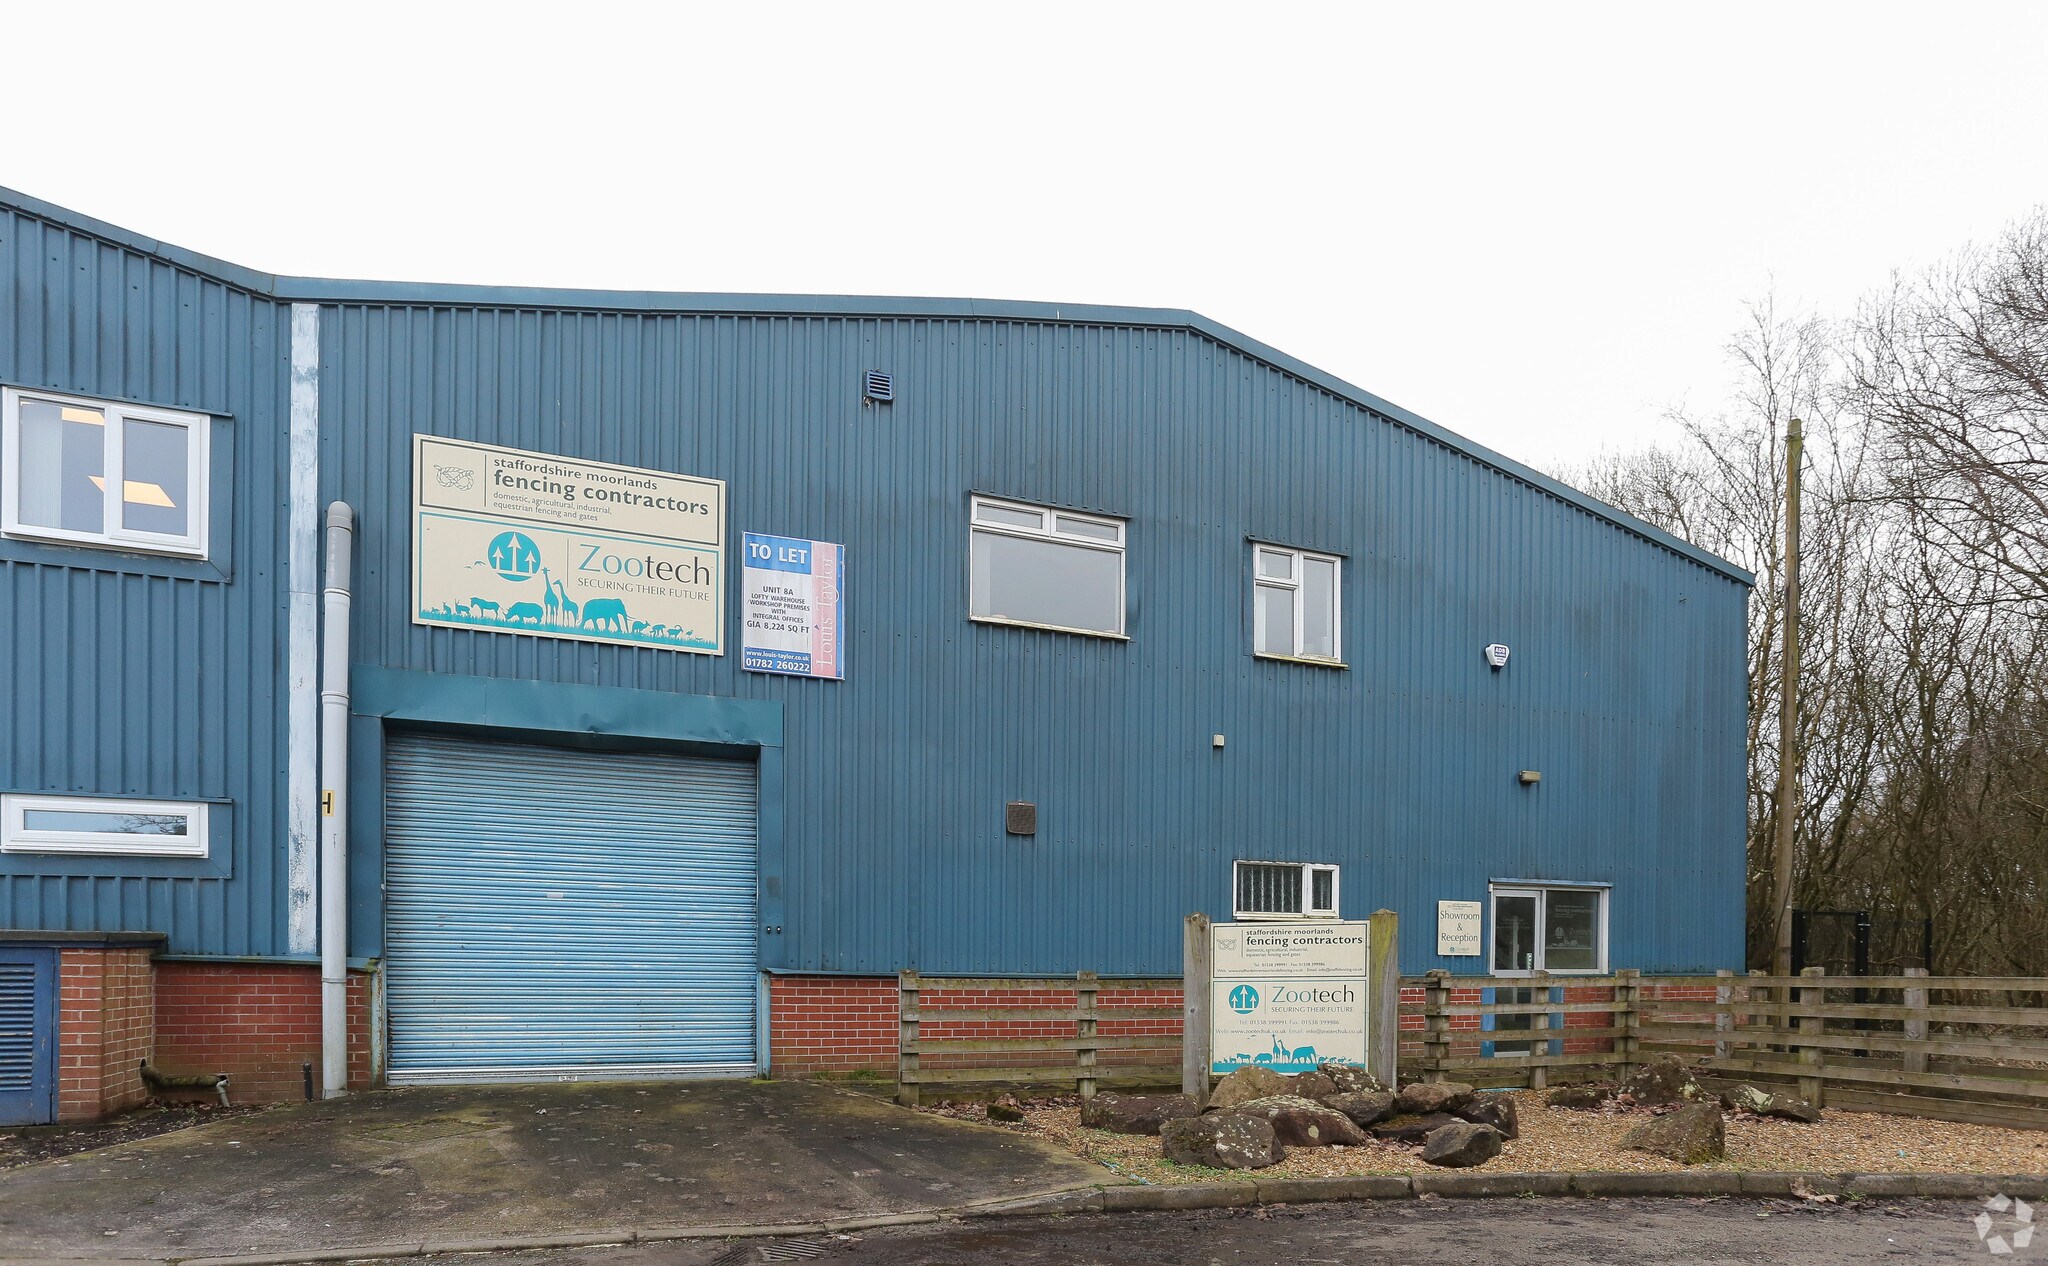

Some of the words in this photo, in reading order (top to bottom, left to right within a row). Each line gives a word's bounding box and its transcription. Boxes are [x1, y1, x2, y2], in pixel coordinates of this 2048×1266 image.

[493, 458, 582, 479] staffordshire
[586, 472, 658, 490] moorlands
[494, 470, 576, 501] fencing
[583, 486, 709, 516] contractors
[493, 491, 531, 504] domestic,
[532, 498, 576, 511] agricultural,
[576, 502, 612, 515] industrial,
[493, 501, 533, 512] equestrian
[535, 505, 562, 518] fencing
[564, 510, 577, 518] and
[578, 514, 598, 522] gates
[749, 542, 772, 560] TO
[778, 546, 808, 564] LET
[578, 544, 710, 586] Zootech
[816, 554, 839, 610] Taylor
[577, 578, 634, 592] SECURING
[636, 584, 666, 596] THEIR
[669, 588, 710, 602] FUTURE
[762, 586, 781, 594] UNIT
[783, 588, 794, 596] 8A
[747, 599, 782, 608] /WORKSHOP
[783, 603, 811, 612] PREMISES
[751, 592, 769, 600] LOFTY
[770, 595, 806, 605] WAREHOUSE
[752, 612, 780, 621] INTEGRAL
[746, 620, 761, 629] GIA
[764, 622, 785, 631] 8,224
[787, 625, 798, 634] SQ
[816, 617, 833, 669] Louis
[746, 650, 810, 662] www.louis-taylor.co.uk
[746, 658, 773, 668] 01782
[776, 660, 810, 672] 260222
[1440, 910, 1480, 920] Showroom
[1456, 922, 1463, 932] &
[1246, 936, 1289, 948] fencing
[1292, 936, 1363, 945] contractors
[1441, 932, 1478, 944] Reception
[1271, 984, 1354, 1003] Zootech
